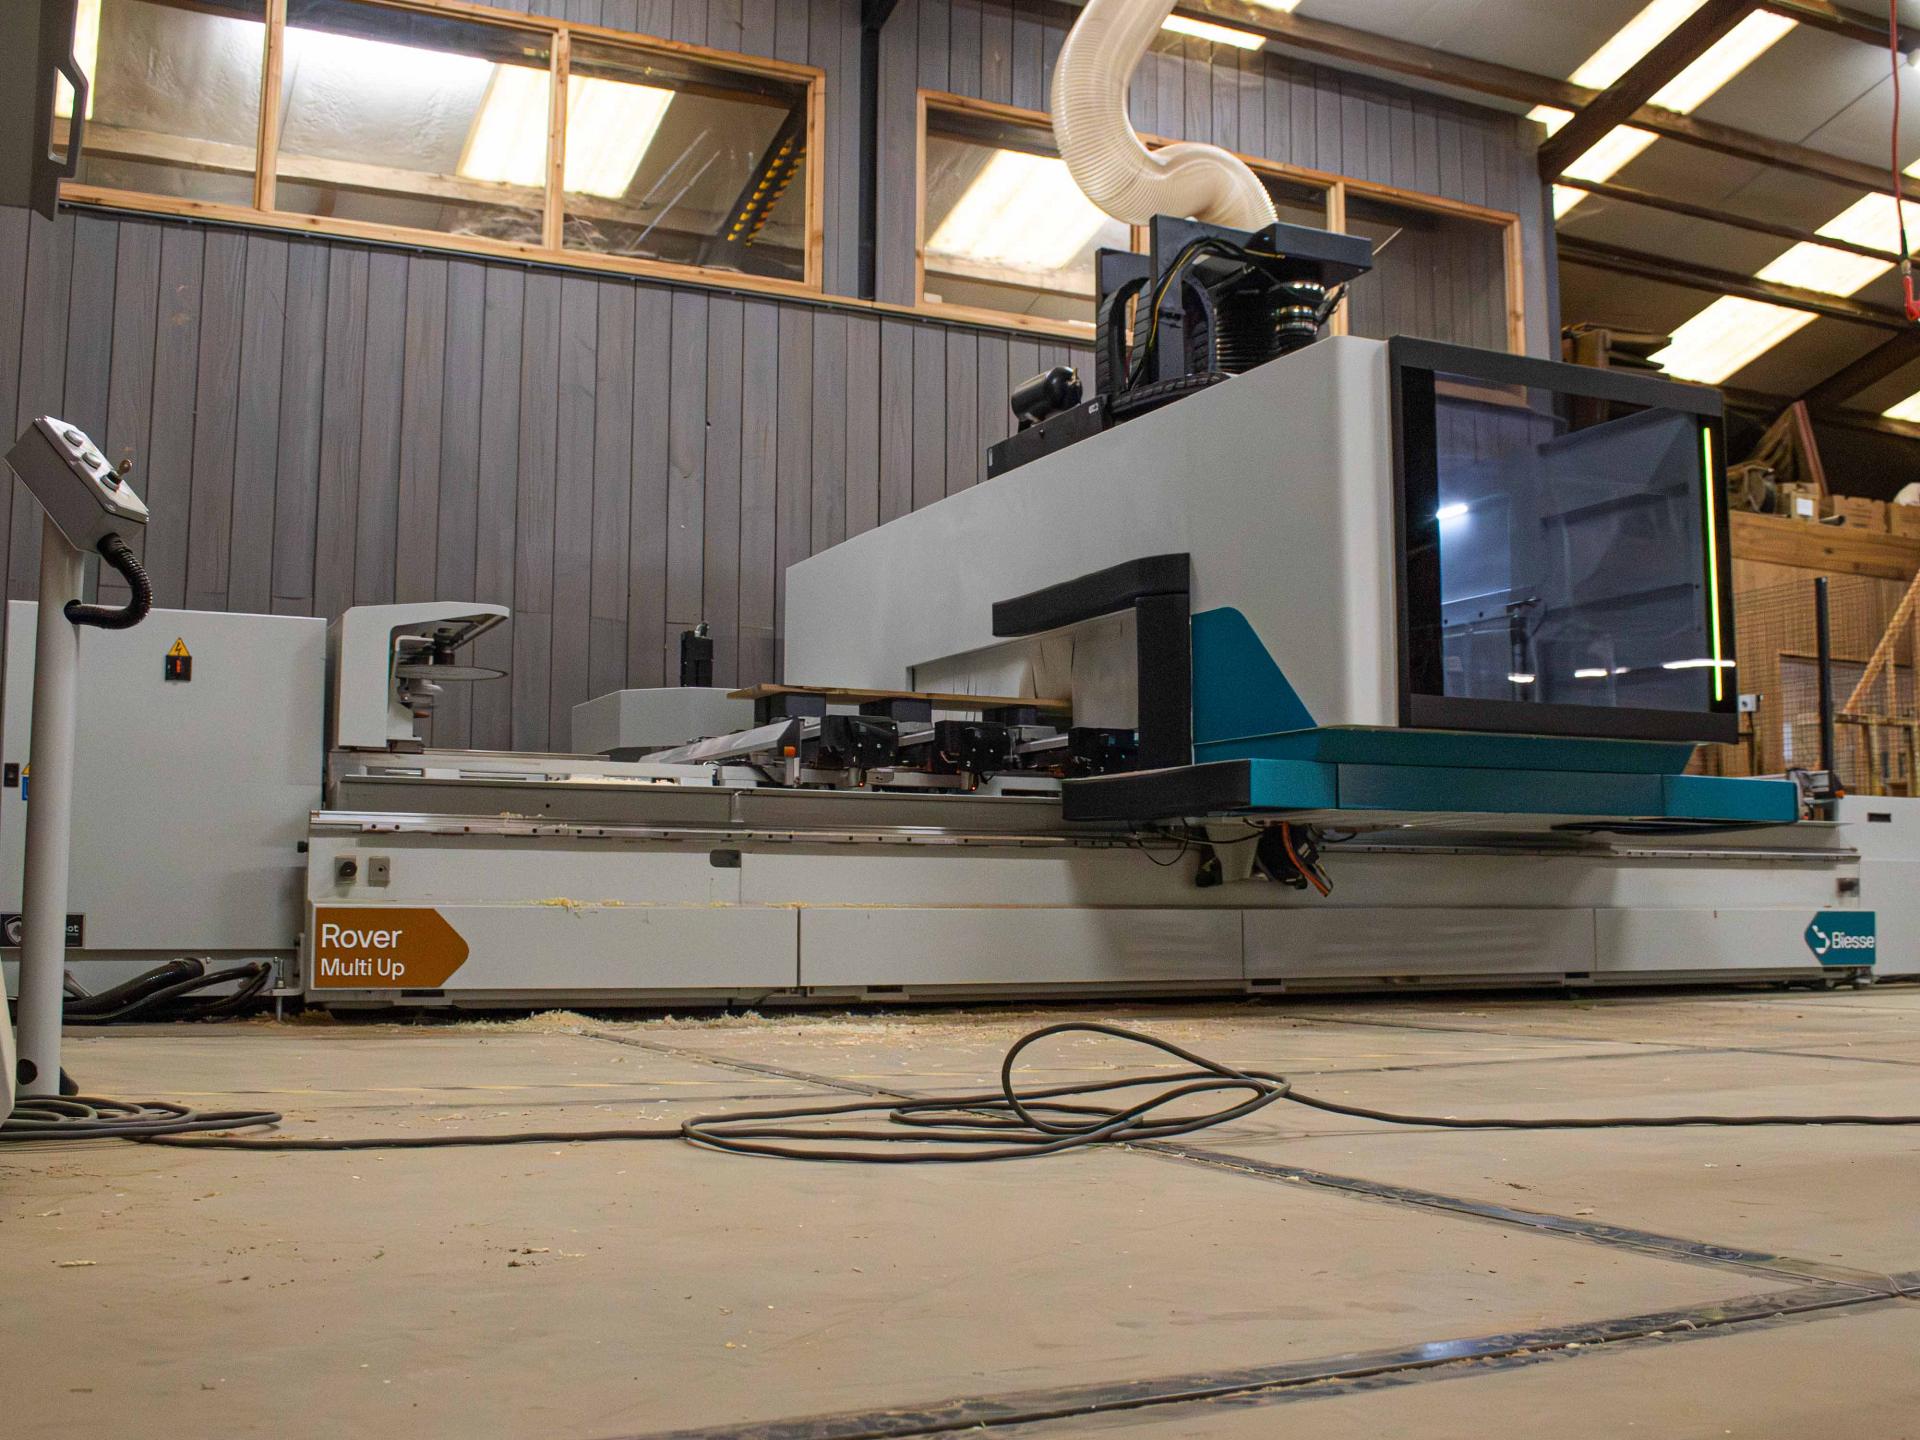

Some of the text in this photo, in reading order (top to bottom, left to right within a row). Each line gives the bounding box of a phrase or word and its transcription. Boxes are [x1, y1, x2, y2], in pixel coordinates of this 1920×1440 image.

[321, 923, 403, 949] Rover
[1831, 931, 1875, 949] Biesse
[320, 957, 405, 981] Multi Up
